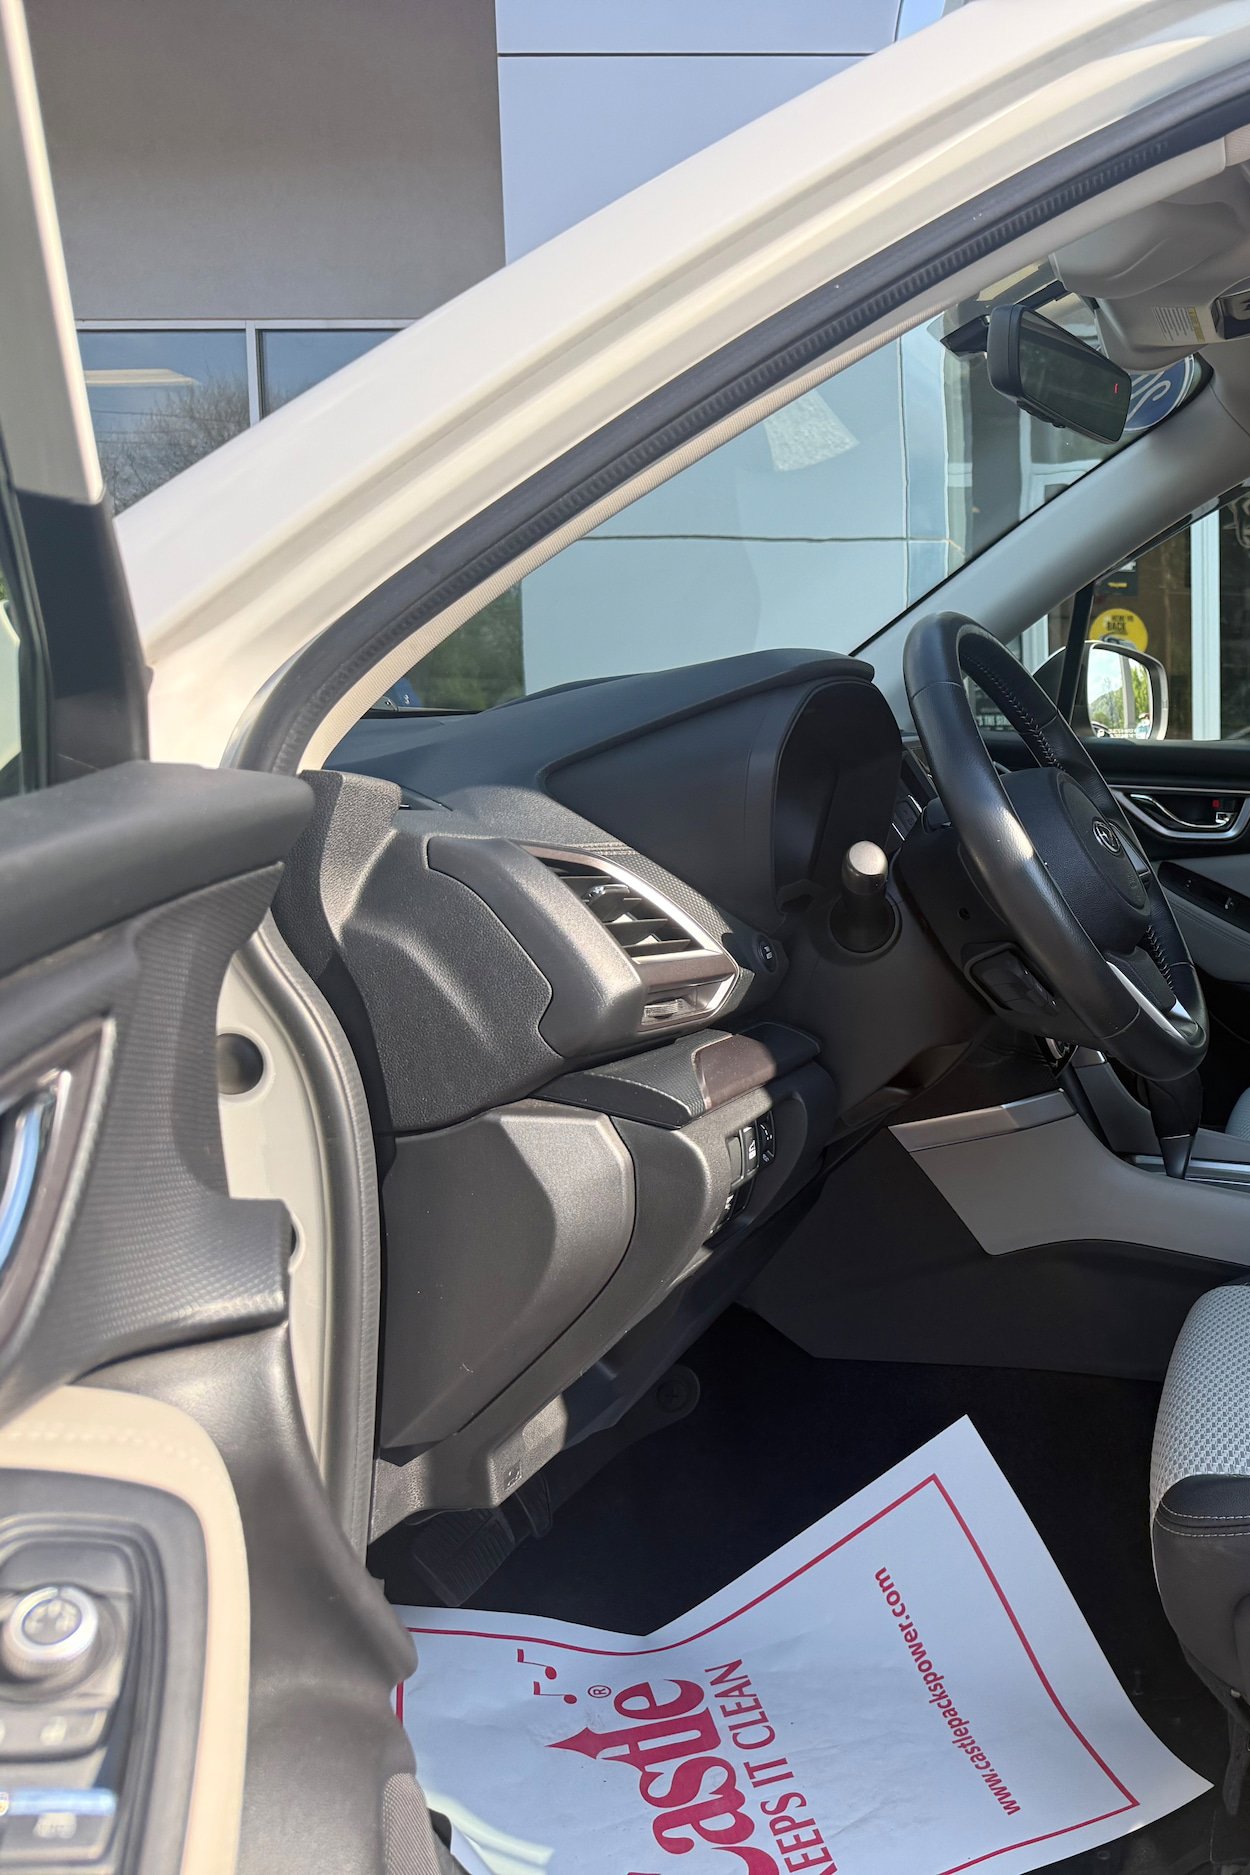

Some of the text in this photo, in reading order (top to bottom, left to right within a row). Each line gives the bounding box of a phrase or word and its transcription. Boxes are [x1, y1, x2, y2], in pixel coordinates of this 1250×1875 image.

[704, 1658, 776, 1750] CLEAN
[874, 1567, 1021, 1816] www.castlepackspower.com
[743, 1757, 795, 1788] IT
